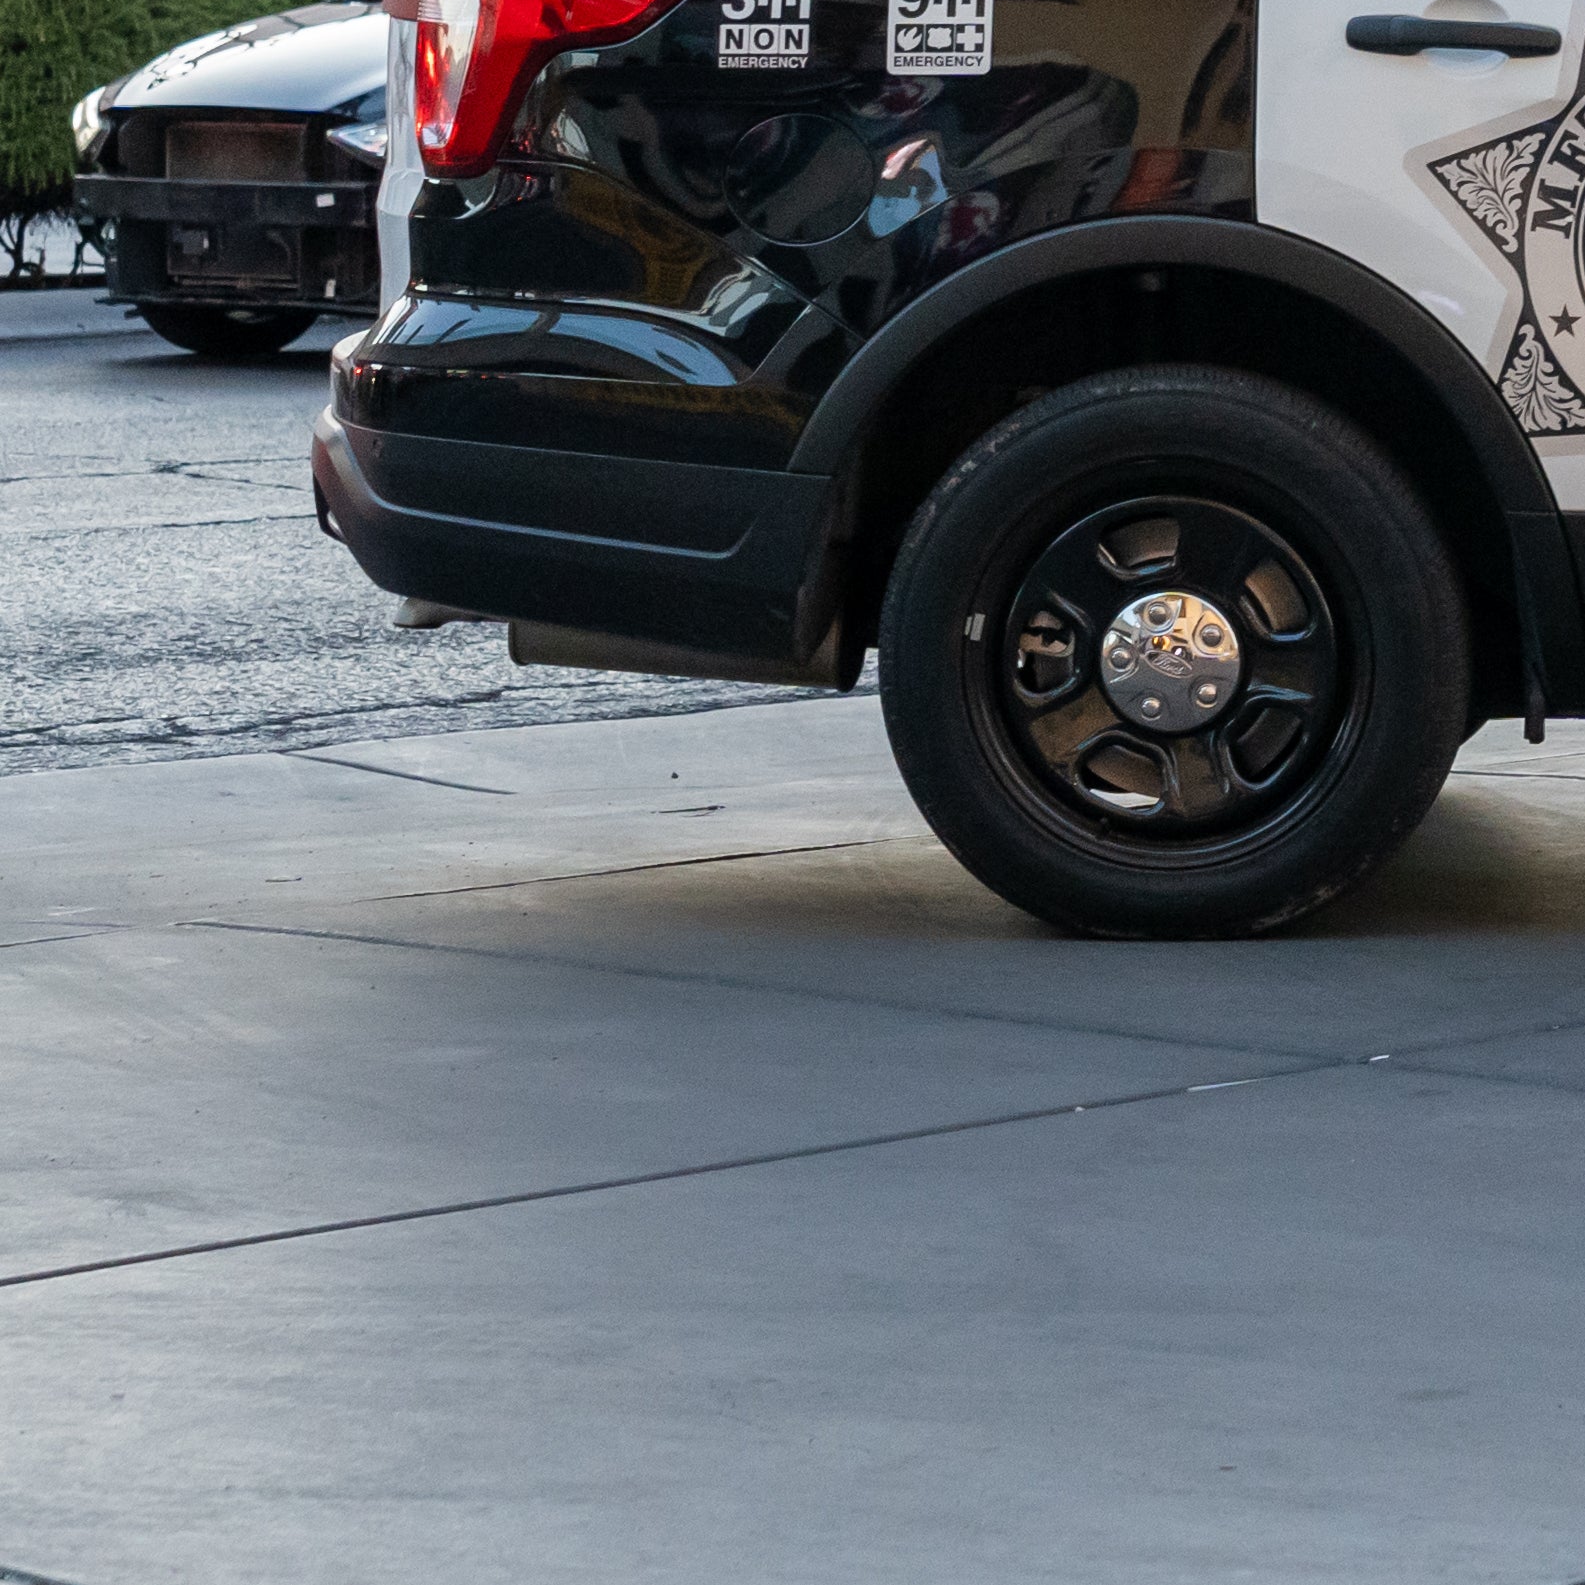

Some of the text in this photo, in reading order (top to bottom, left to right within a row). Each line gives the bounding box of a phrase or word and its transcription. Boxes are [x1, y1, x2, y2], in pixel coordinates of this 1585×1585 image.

[723, 27, 804, 52] NON
[718, 56, 809, 69] EMERGENCY
[894, 55, 984, 68] EMERGENCY
